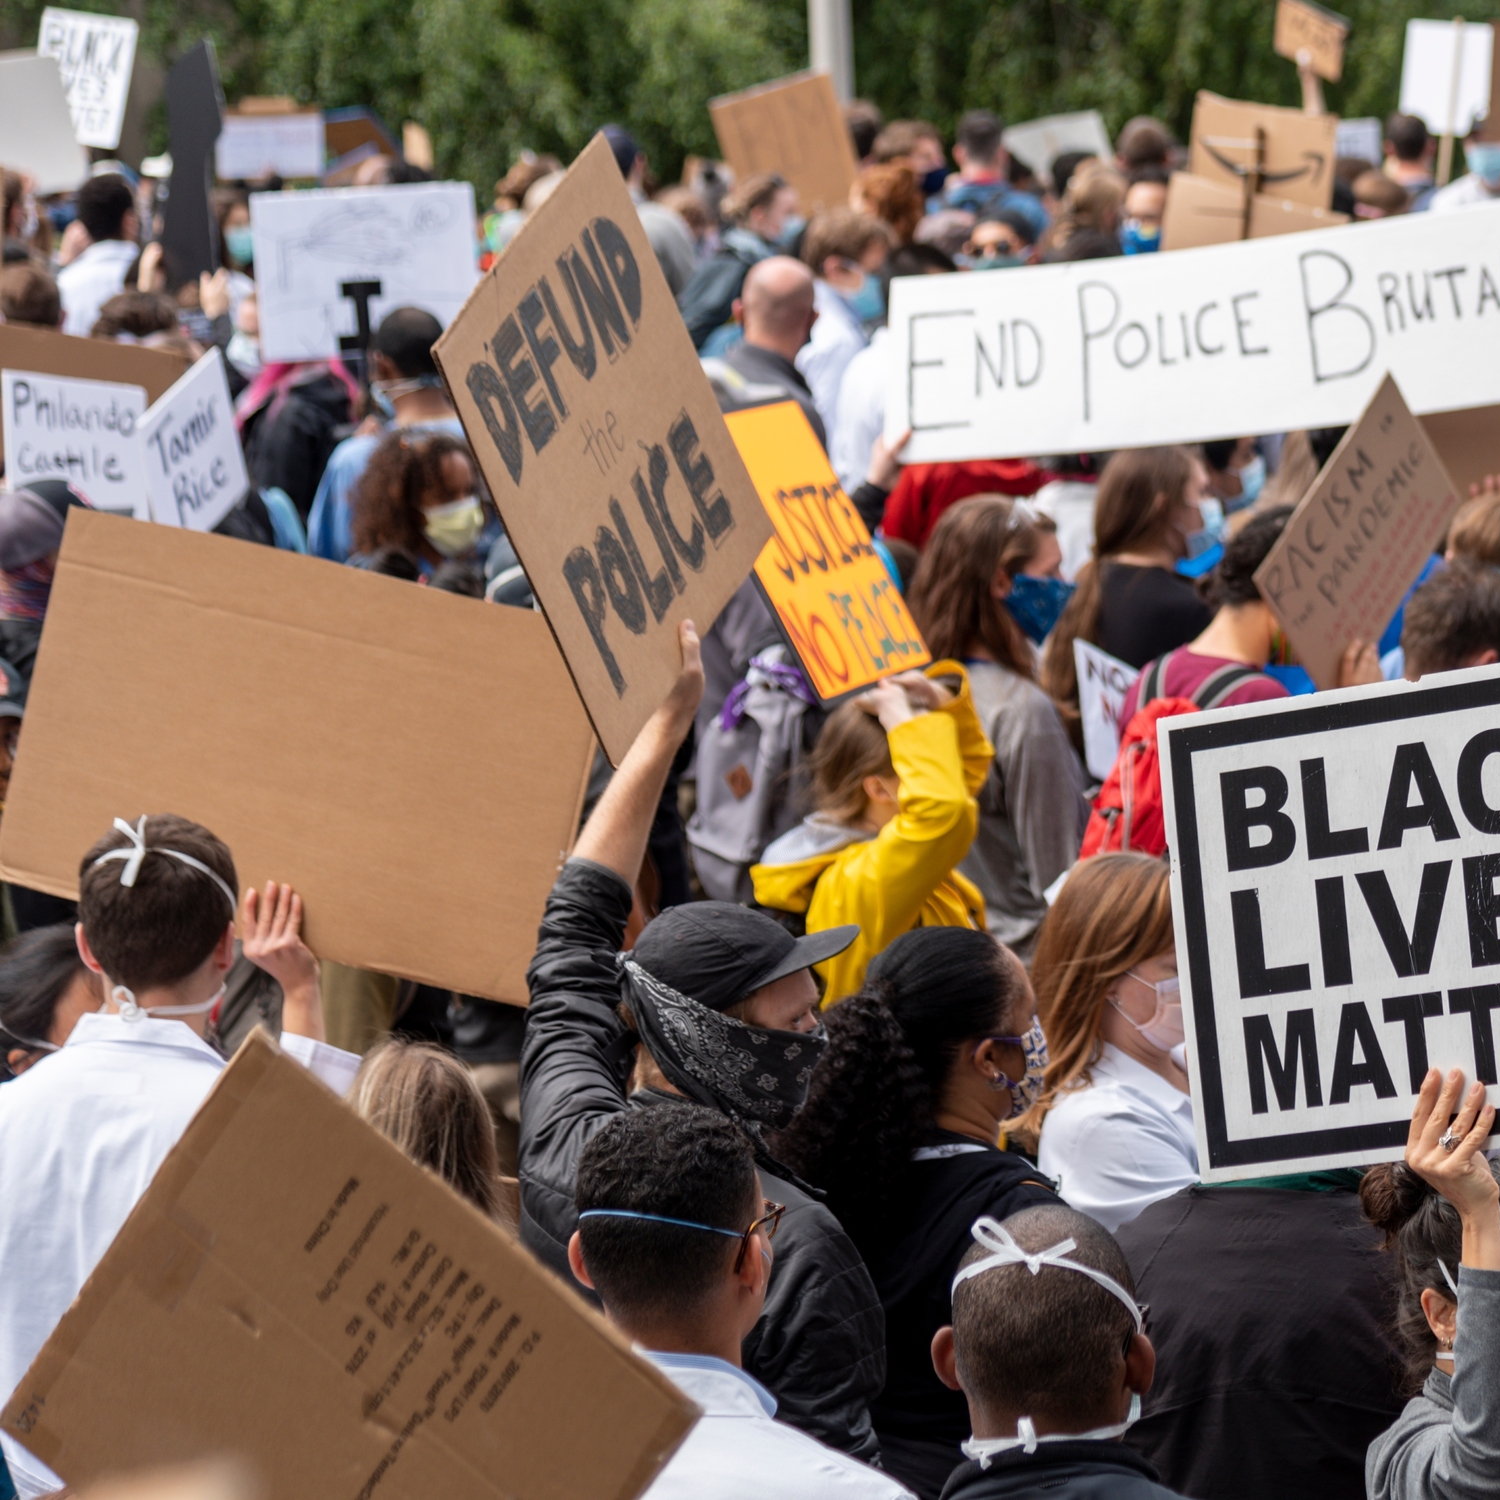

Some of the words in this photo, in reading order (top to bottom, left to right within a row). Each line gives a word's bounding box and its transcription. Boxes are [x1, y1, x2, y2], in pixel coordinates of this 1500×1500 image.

[465, 216, 643, 487] DEFUND
[908, 308, 1044, 431] END
[1077, 279, 1270, 423] POLICE
[12, 380, 137, 437] Philando
[148, 393, 218, 476] Tamir
[579, 409, 626, 476] the
[172, 456, 229, 525] Rice
[562, 407, 736, 699] POLICE
[772, 483, 876, 583] JUSTICE
[1263, 446, 1375, 616] RACISM
[1317, 441, 1425, 608] PANDEMIC
[776, 600, 849, 696] NO
[828, 579, 923, 676] PEACE
[334, 1178, 358, 1209] Made
[304, 1221, 330, 1254] China
[348, 1202, 390, 1258] Household
[406, 1243, 436, 1282] Carton
[314, 1277, 338, 1305] Only
[333, 1256, 352, 1280] Use
[344, 1315, 363, 1337] KG
[402, 1290, 429, 1324] Black
[492, 1314, 521, 1350] Model
